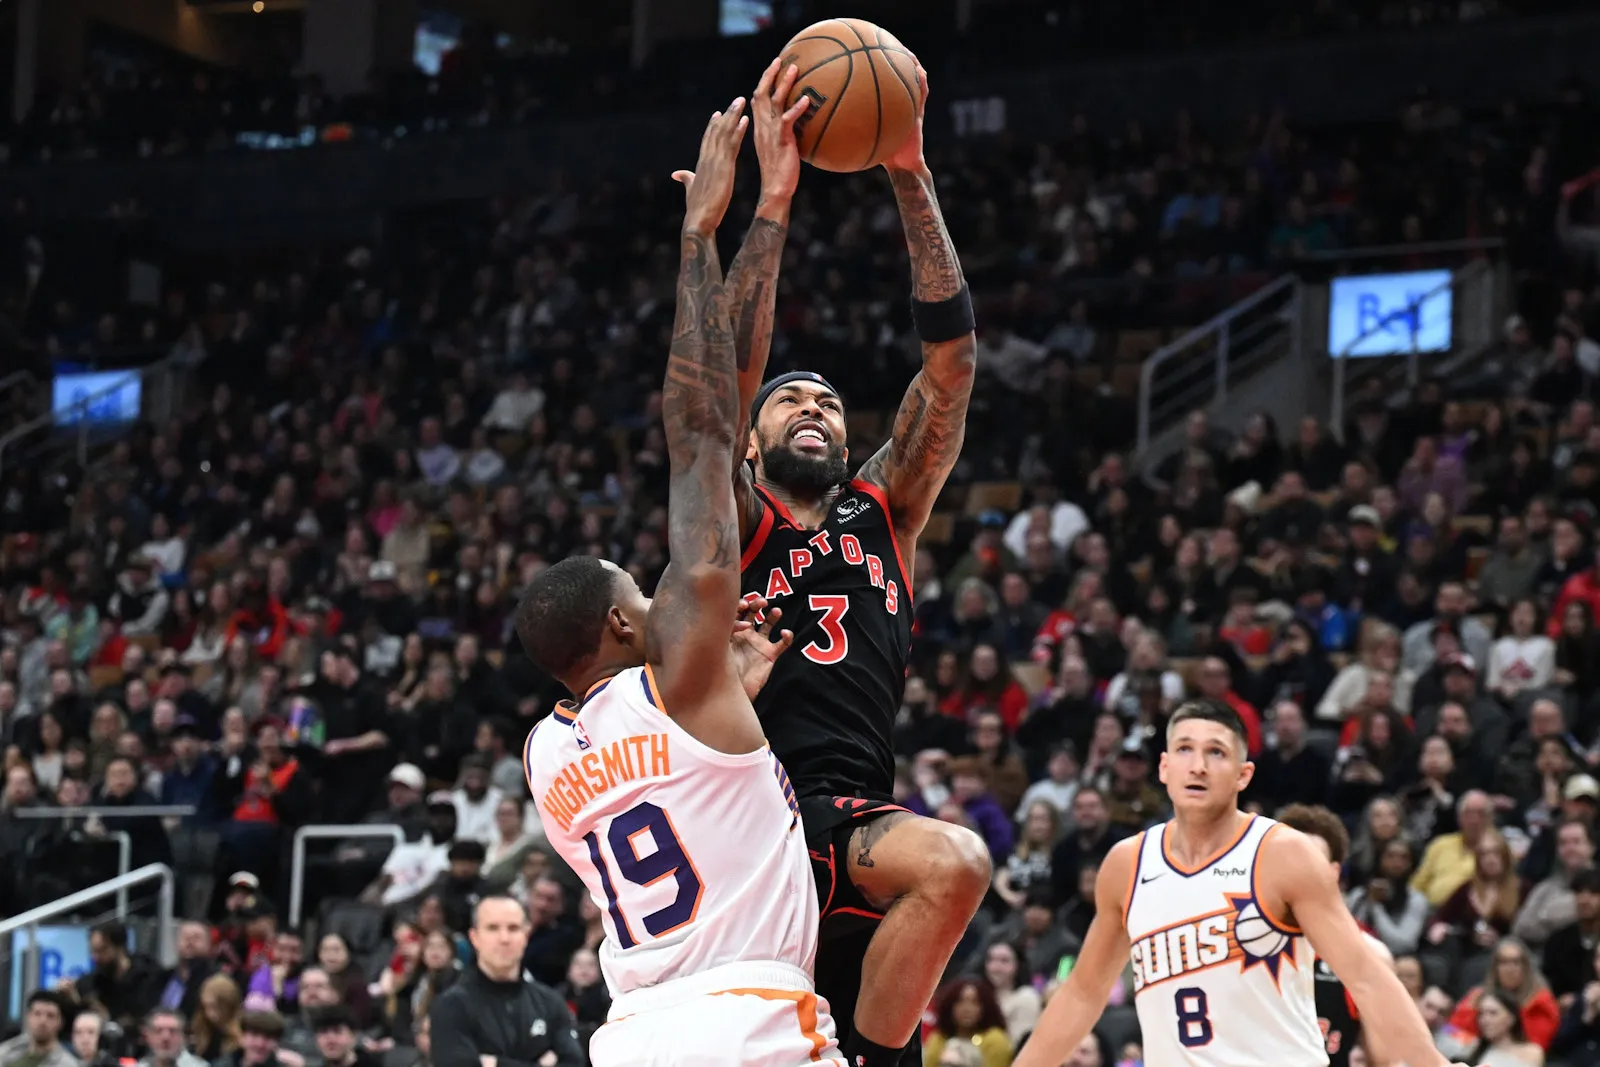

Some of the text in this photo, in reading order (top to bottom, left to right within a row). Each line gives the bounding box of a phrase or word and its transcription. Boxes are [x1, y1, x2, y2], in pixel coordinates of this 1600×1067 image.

[837, 501, 871, 524] Sun Life
[801, 594, 849, 665] 3
[543, 733, 671, 833] HIGHSMITH
[582, 801, 706, 950] 19
[1213, 867, 1247, 879] PayPal
[1130, 914, 1230, 992] SUNS
[1174, 987, 1214, 1049] 8
